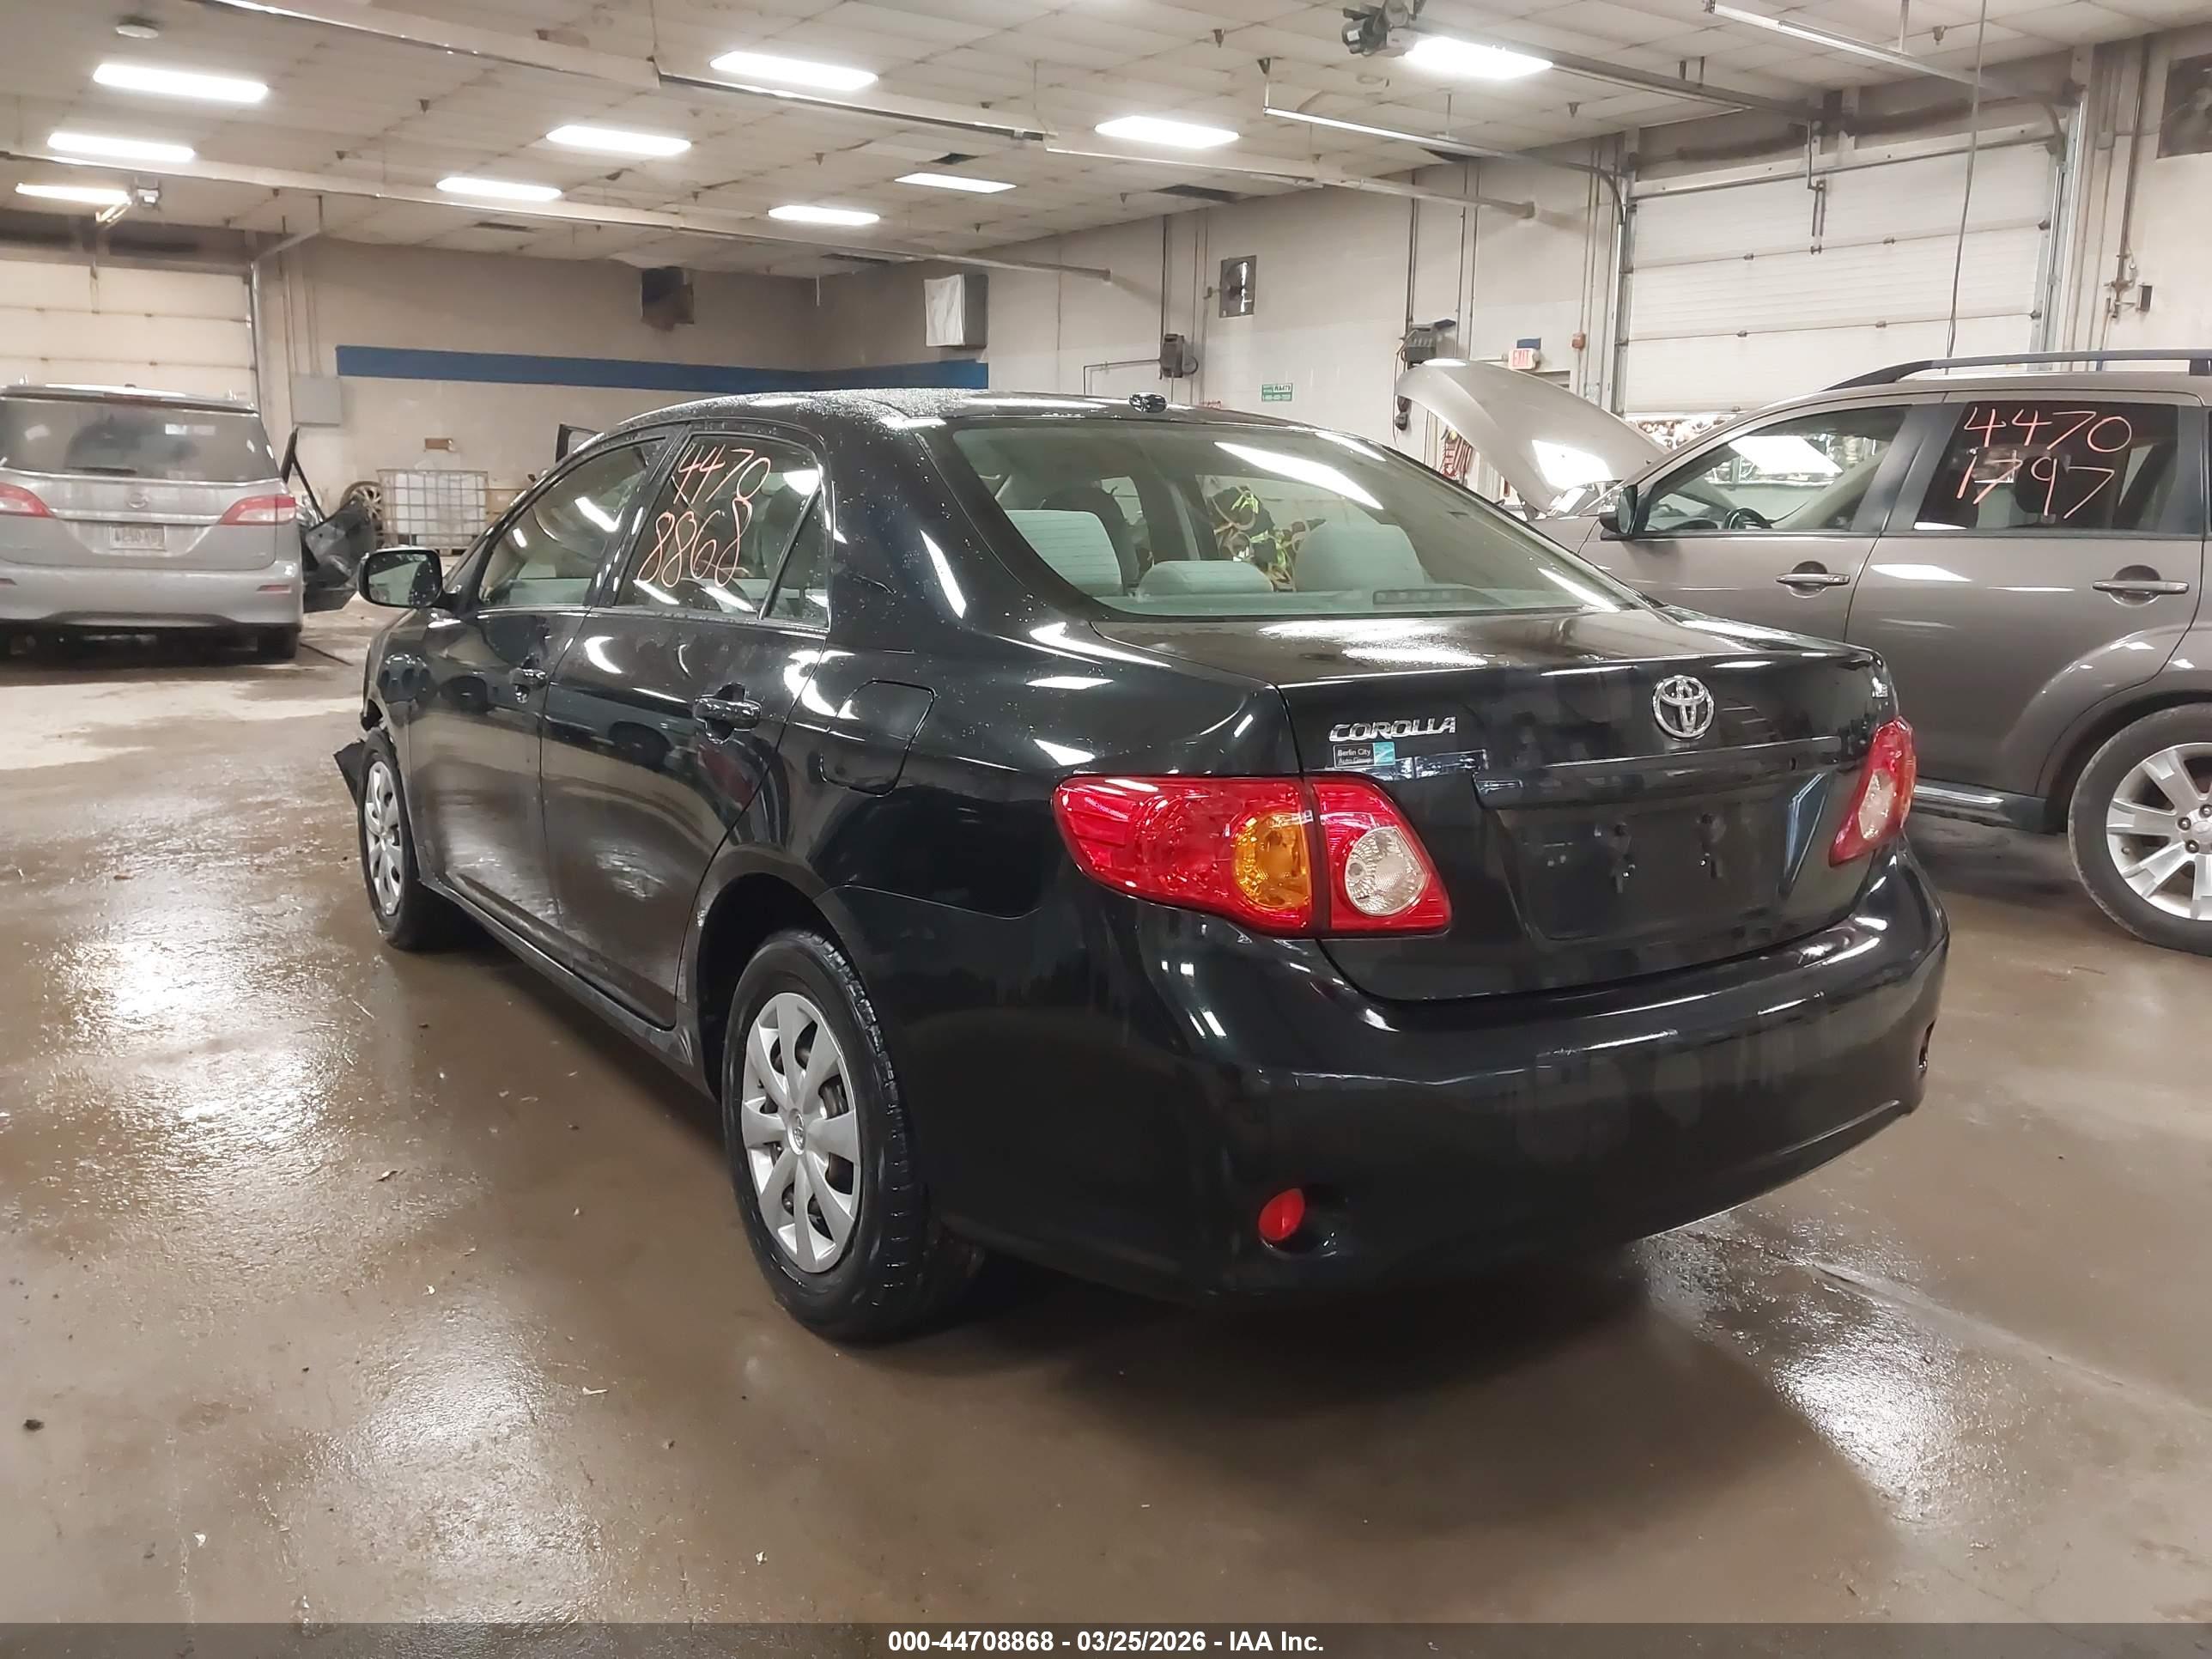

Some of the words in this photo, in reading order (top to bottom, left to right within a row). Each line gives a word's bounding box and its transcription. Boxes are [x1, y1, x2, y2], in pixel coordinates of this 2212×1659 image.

[1964, 406, 2132, 453] 4470
[673, 444, 771, 504] 4470
[1956, 455, 2115, 520] 1797
[637, 497, 753, 588] 8868
[1328, 716, 1456, 742] COROLLA
[1337, 748, 1357, 757] Berlin
